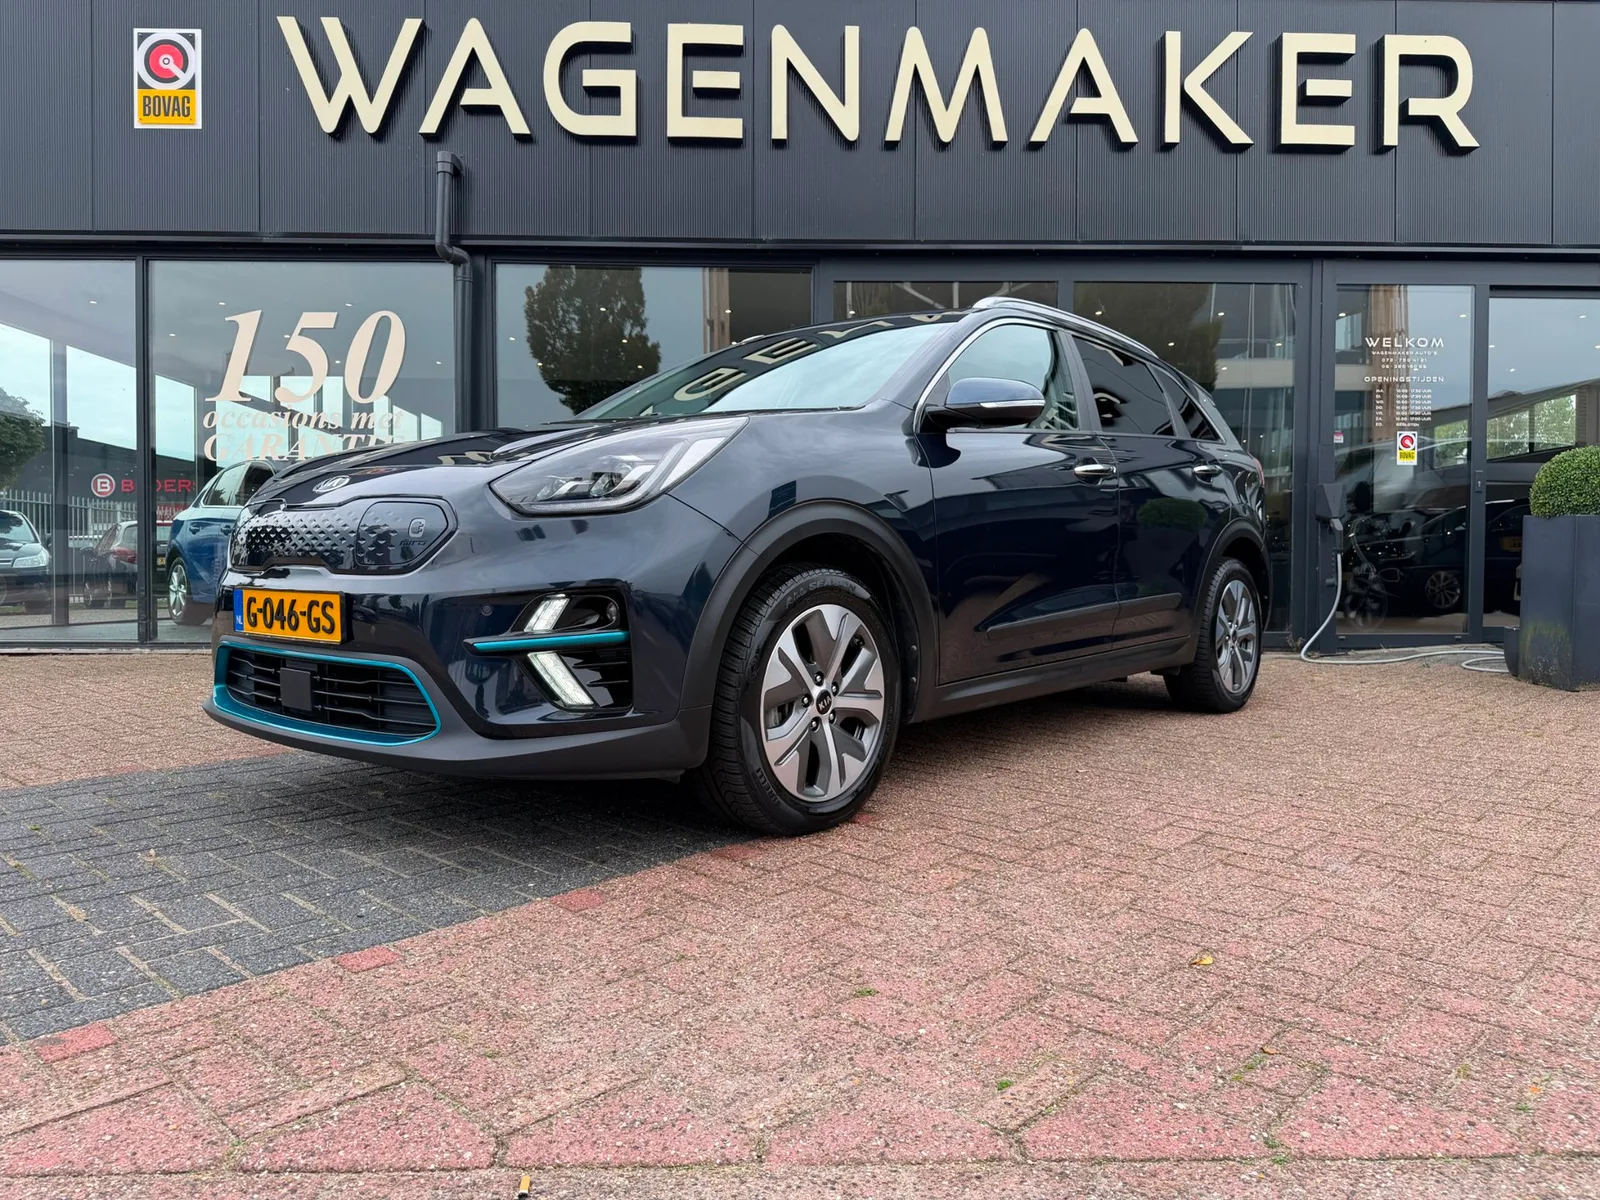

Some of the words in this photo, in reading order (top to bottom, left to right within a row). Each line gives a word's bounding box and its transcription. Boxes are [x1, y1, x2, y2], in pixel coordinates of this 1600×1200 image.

[276, 16, 1480, 149] WAGENMAKER
[142, 95, 191, 118] BOVAG
[1365, 337, 1444, 347] WELKOM
[204, 309, 406, 404] 150
[203, 405, 341, 429] occasions
[350, 408, 404, 429] met
[1399, 451, 1415, 460] BOVAG
[235, 615, 243, 625] NL
[246, 596, 335, 635] G-046-GS
